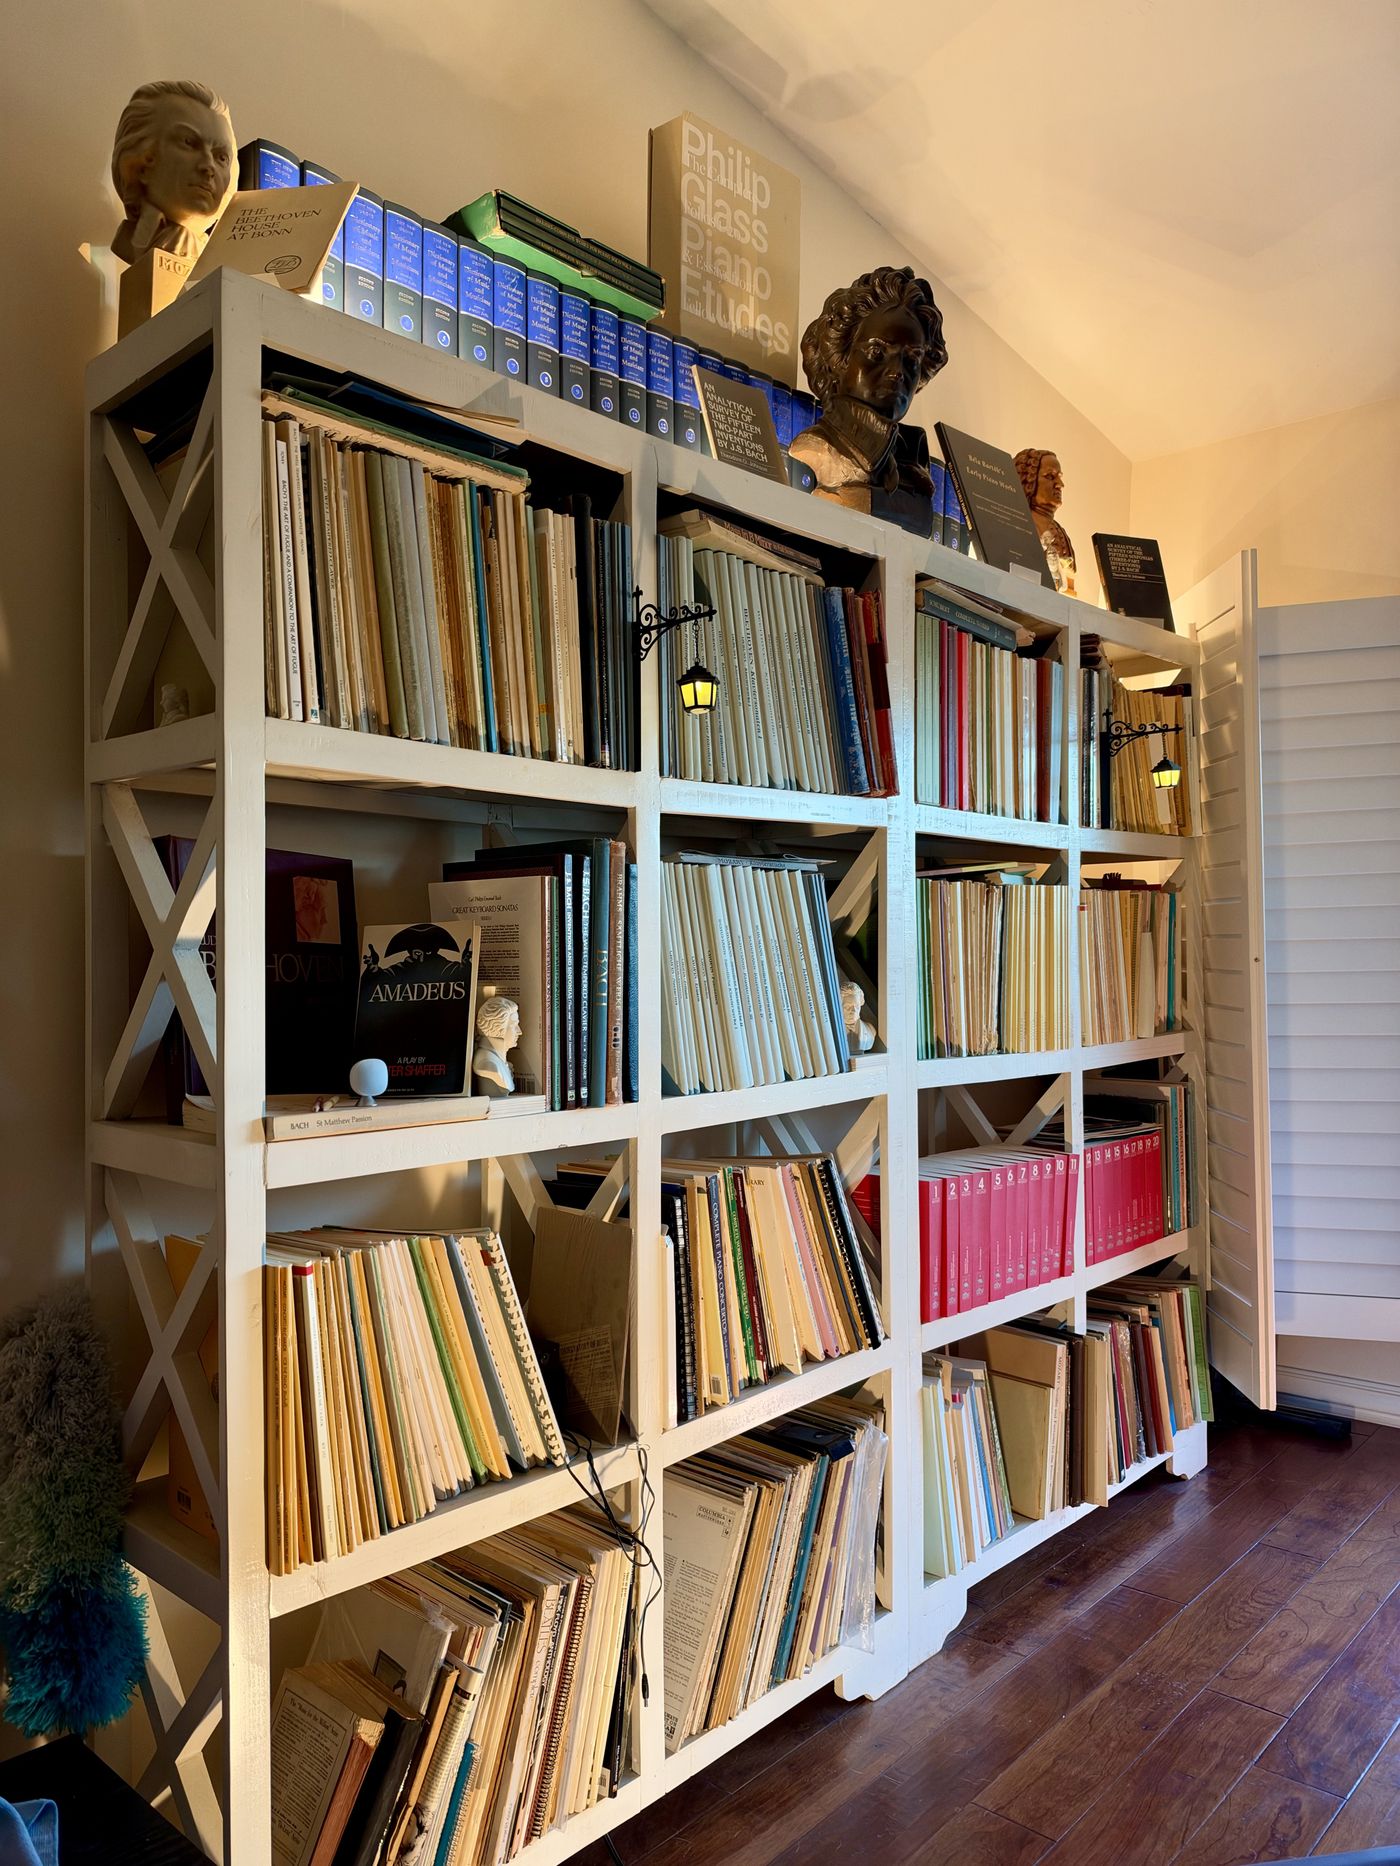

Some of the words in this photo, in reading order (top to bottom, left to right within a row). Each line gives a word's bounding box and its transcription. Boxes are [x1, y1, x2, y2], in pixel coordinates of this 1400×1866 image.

[683, 120, 770, 215] Philip
[236, 209, 321, 224] BEETHOVEN
[240, 208, 268, 216] THE
[682, 171, 768, 254] Glass
[232, 222, 280, 232] HOUSE
[251, 228, 292, 239] BONN
[681, 216, 771, 300] Piano
[531, 296, 556, 312] Dictionary
[681, 266, 789, 354] Etudes
[562, 311, 588, 326] Dictionary
[592, 326, 616, 340] Dictionary
[621, 337, 644, 351] Dictionary
[704, 382, 714, 392] AN
[706, 392, 756, 416] ANALYTICAL
[708, 401, 739, 418] SURVEY
[742, 414, 752, 422] OF
[710, 410, 726, 421] THE
[728, 416, 761, 434] FIFTEEN
[713, 420, 753, 440] TWO-PART
[715, 430, 764, 452] INVENTIONS
[718, 439, 728, 449] BY
[746, 449, 767, 462] BACH
[967, 467, 981, 480] Early
[1000, 480, 1016, 493] Works
[288, 612, 294, 621] TO
[291, 646, 296, 654] OF
[744, 608, 754, 664] BEETHOVEN
[582, 888, 590, 918] BACH
[594, 949, 608, 1006] BACH
[368, 981, 465, 1002] AMADEUS
[405, 1064, 446, 1076] SHAFFER
[324, 1118, 350, 1126] Matthew
[1131, 1142, 1136, 1153] 17
[1137, 1140, 1143, 1151] 18
[1146, 1139, 1151, 1149] 19
[1153, 1136, 1159, 1146] 20
[1094, 1151, 1100, 1161] 13
[1104, 1148, 1111, 1160] 14
[1114, 1146, 1120, 1157] 15
[1123, 1144, 1129, 1155] 16
[1070, 1159, 1076, 1169] 11
[1086, 1153, 1091, 1164] 12
[1032, 1165, 1038, 1176] 8
[1046, 1163, 1051, 1174] 9
[1056, 1160, 1064, 1172] 10
[995, 1174, 1000, 1185] 5
[1008, 1170, 1013, 1181] 6
[1020, 1168, 1026, 1179] 7
[950, 1183, 955, 1195] 2
[964, 1180, 969, 1192] 3
[978, 1177, 984, 1190] 4
[934, 1186, 938, 1197] 1
[712, 1202, 720, 1248] COMPLETE
[719, 1282, 728, 1334] CONCERTOS
[699, 1507, 725, 1520] COLUMBIA
[556, 1595, 564, 1614] PINK
[537, 1599, 556, 1654] BEATLES
[552, 1614, 560, 1637] FLOYD
[542, 1640, 554, 1686] ANTHOLOGY
